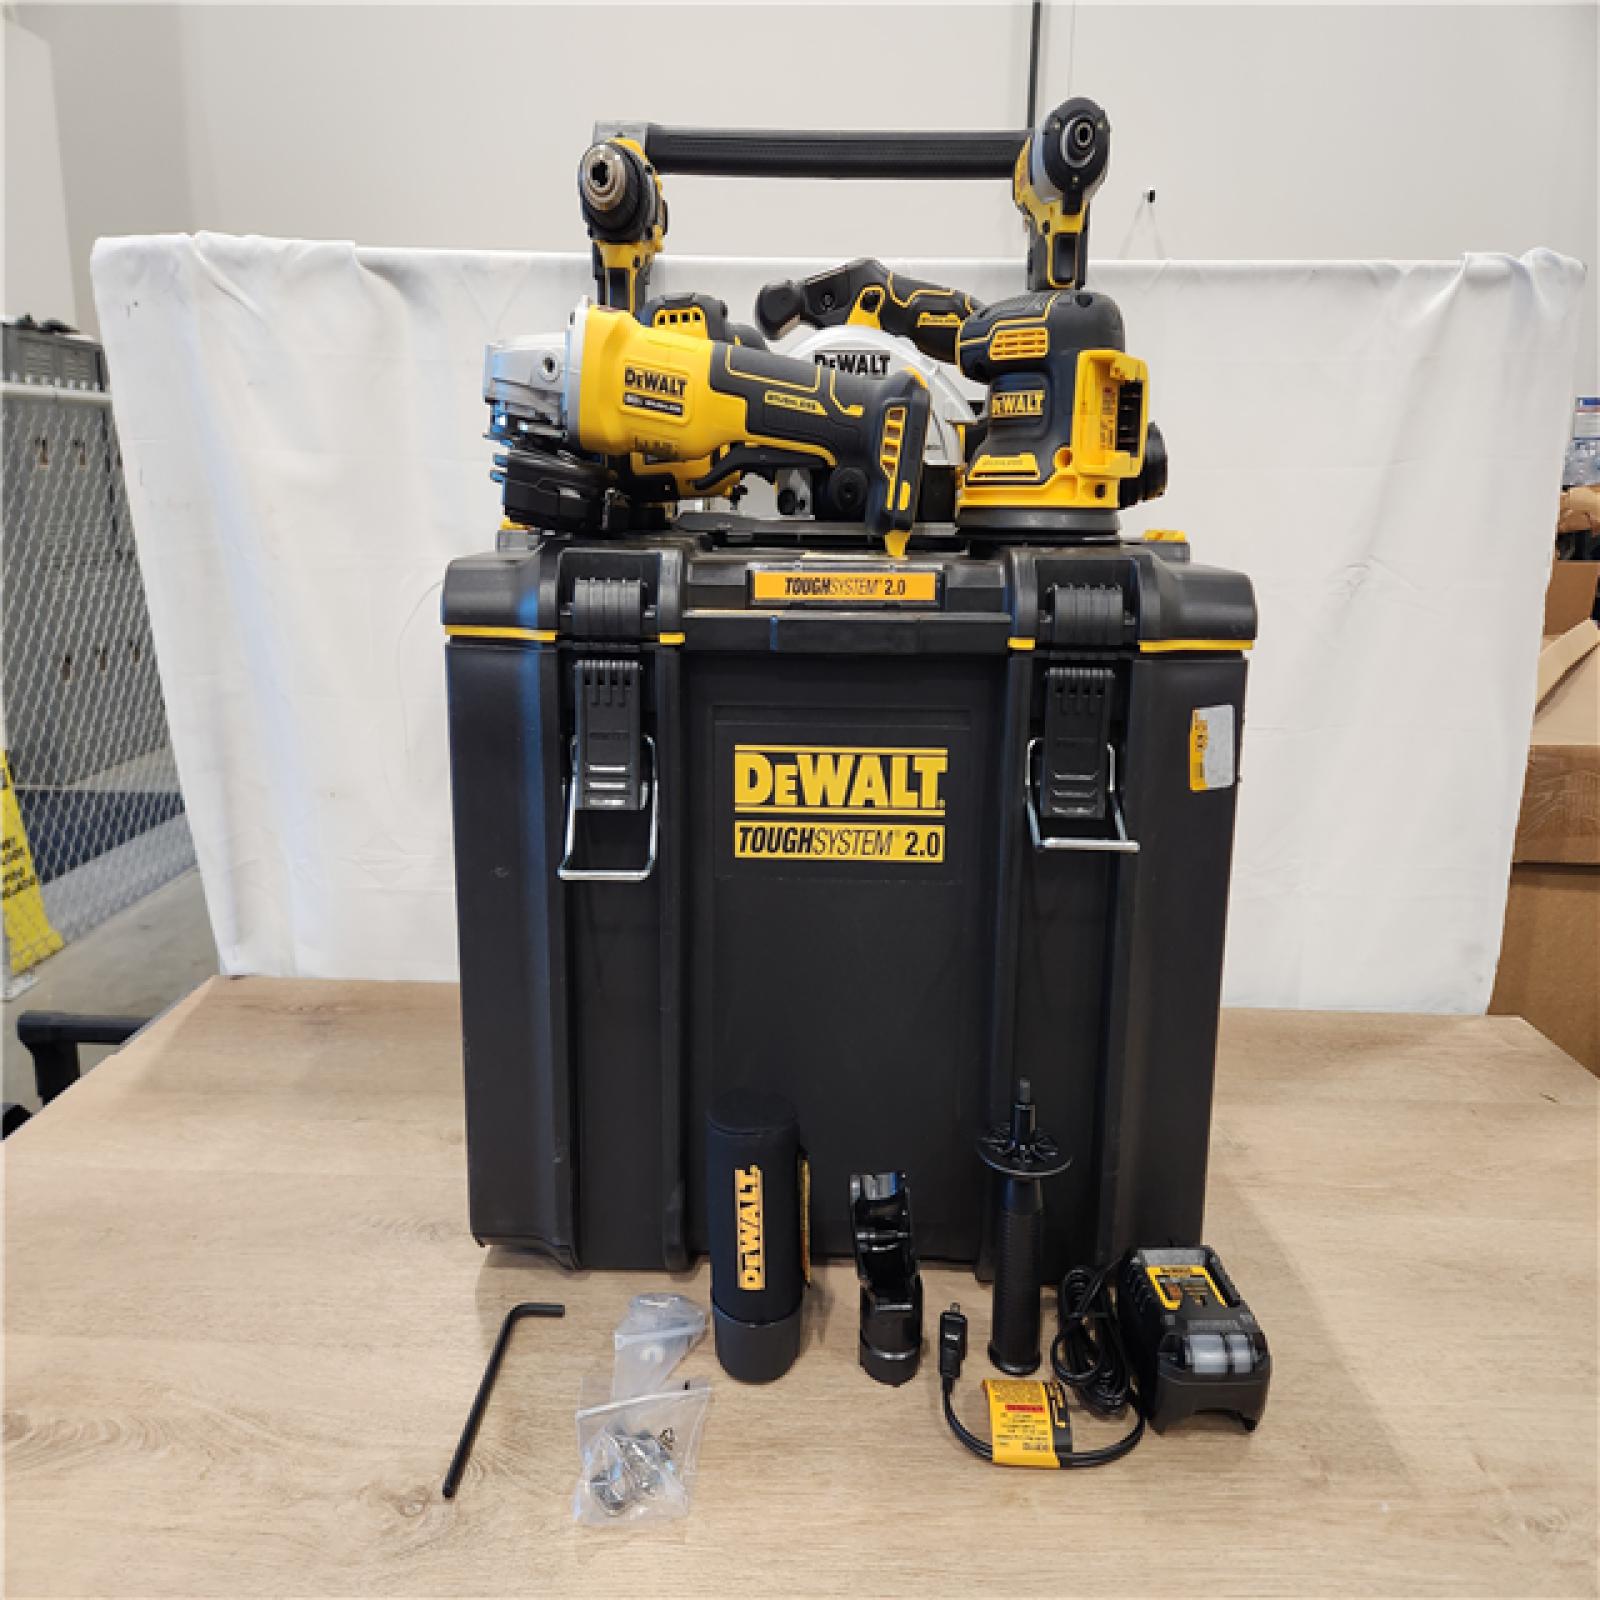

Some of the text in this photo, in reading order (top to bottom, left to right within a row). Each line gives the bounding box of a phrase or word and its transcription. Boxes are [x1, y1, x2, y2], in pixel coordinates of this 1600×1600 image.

[624, 367, 688, 399] DEWALT
[885, 579, 906, 596] 2.0
[734, 752, 949, 809] DEWALT
[739, 827, 942, 858] TOUGHSYSTEM 2.0
[736, 1166, 765, 1290] DEWALT
